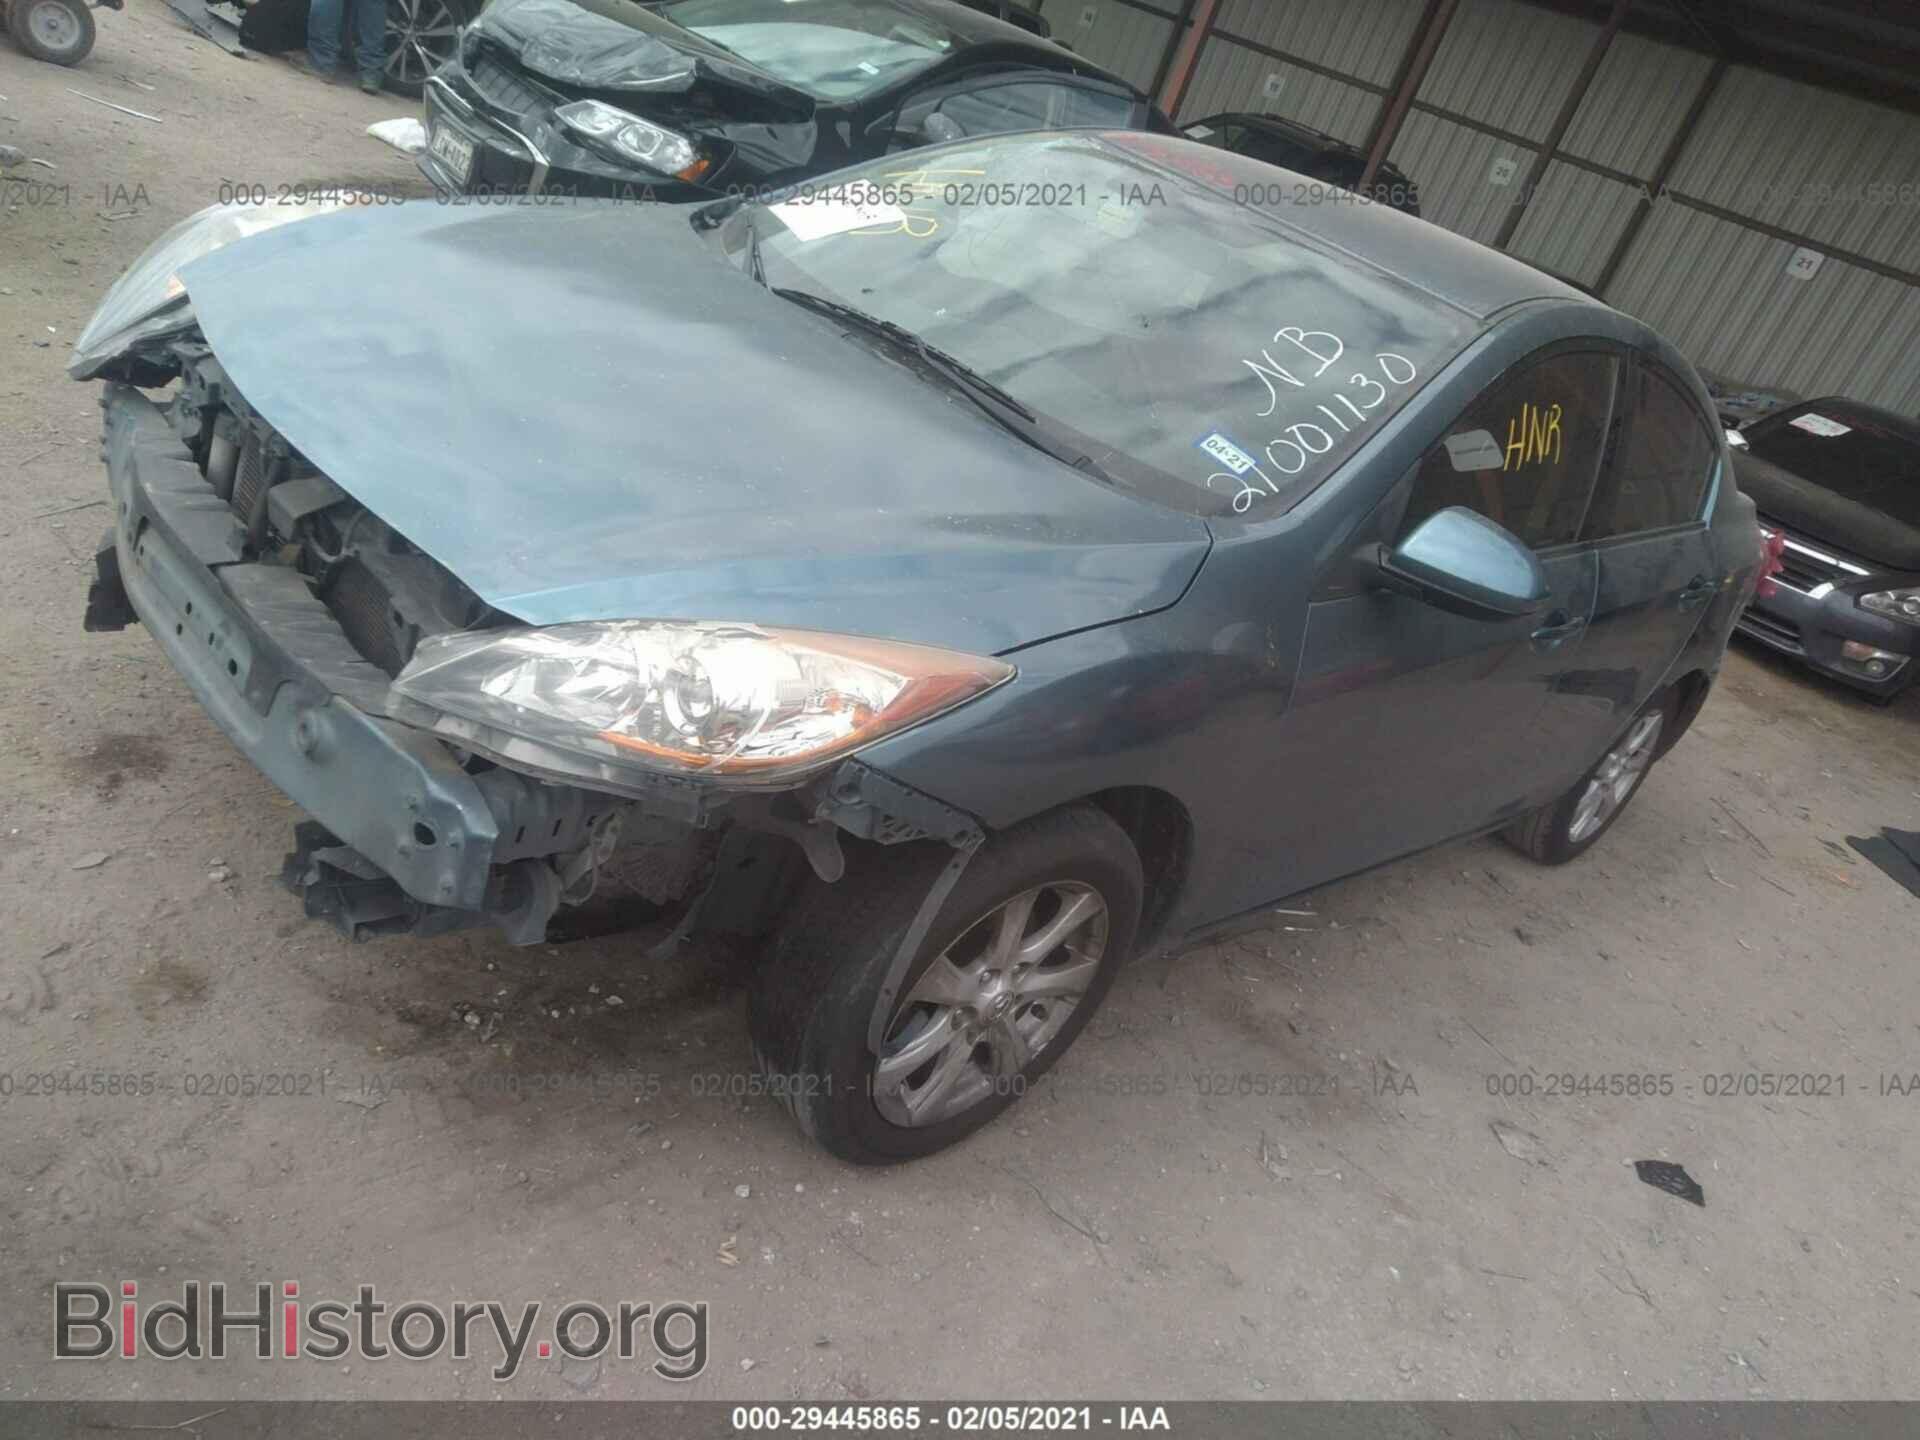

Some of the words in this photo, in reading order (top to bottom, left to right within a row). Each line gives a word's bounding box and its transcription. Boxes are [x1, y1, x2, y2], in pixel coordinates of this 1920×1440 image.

[1796, 257, 1814, 271] 21
[1242, 327, 1344, 417] NB
[1503, 402, 1561, 472] HNR
